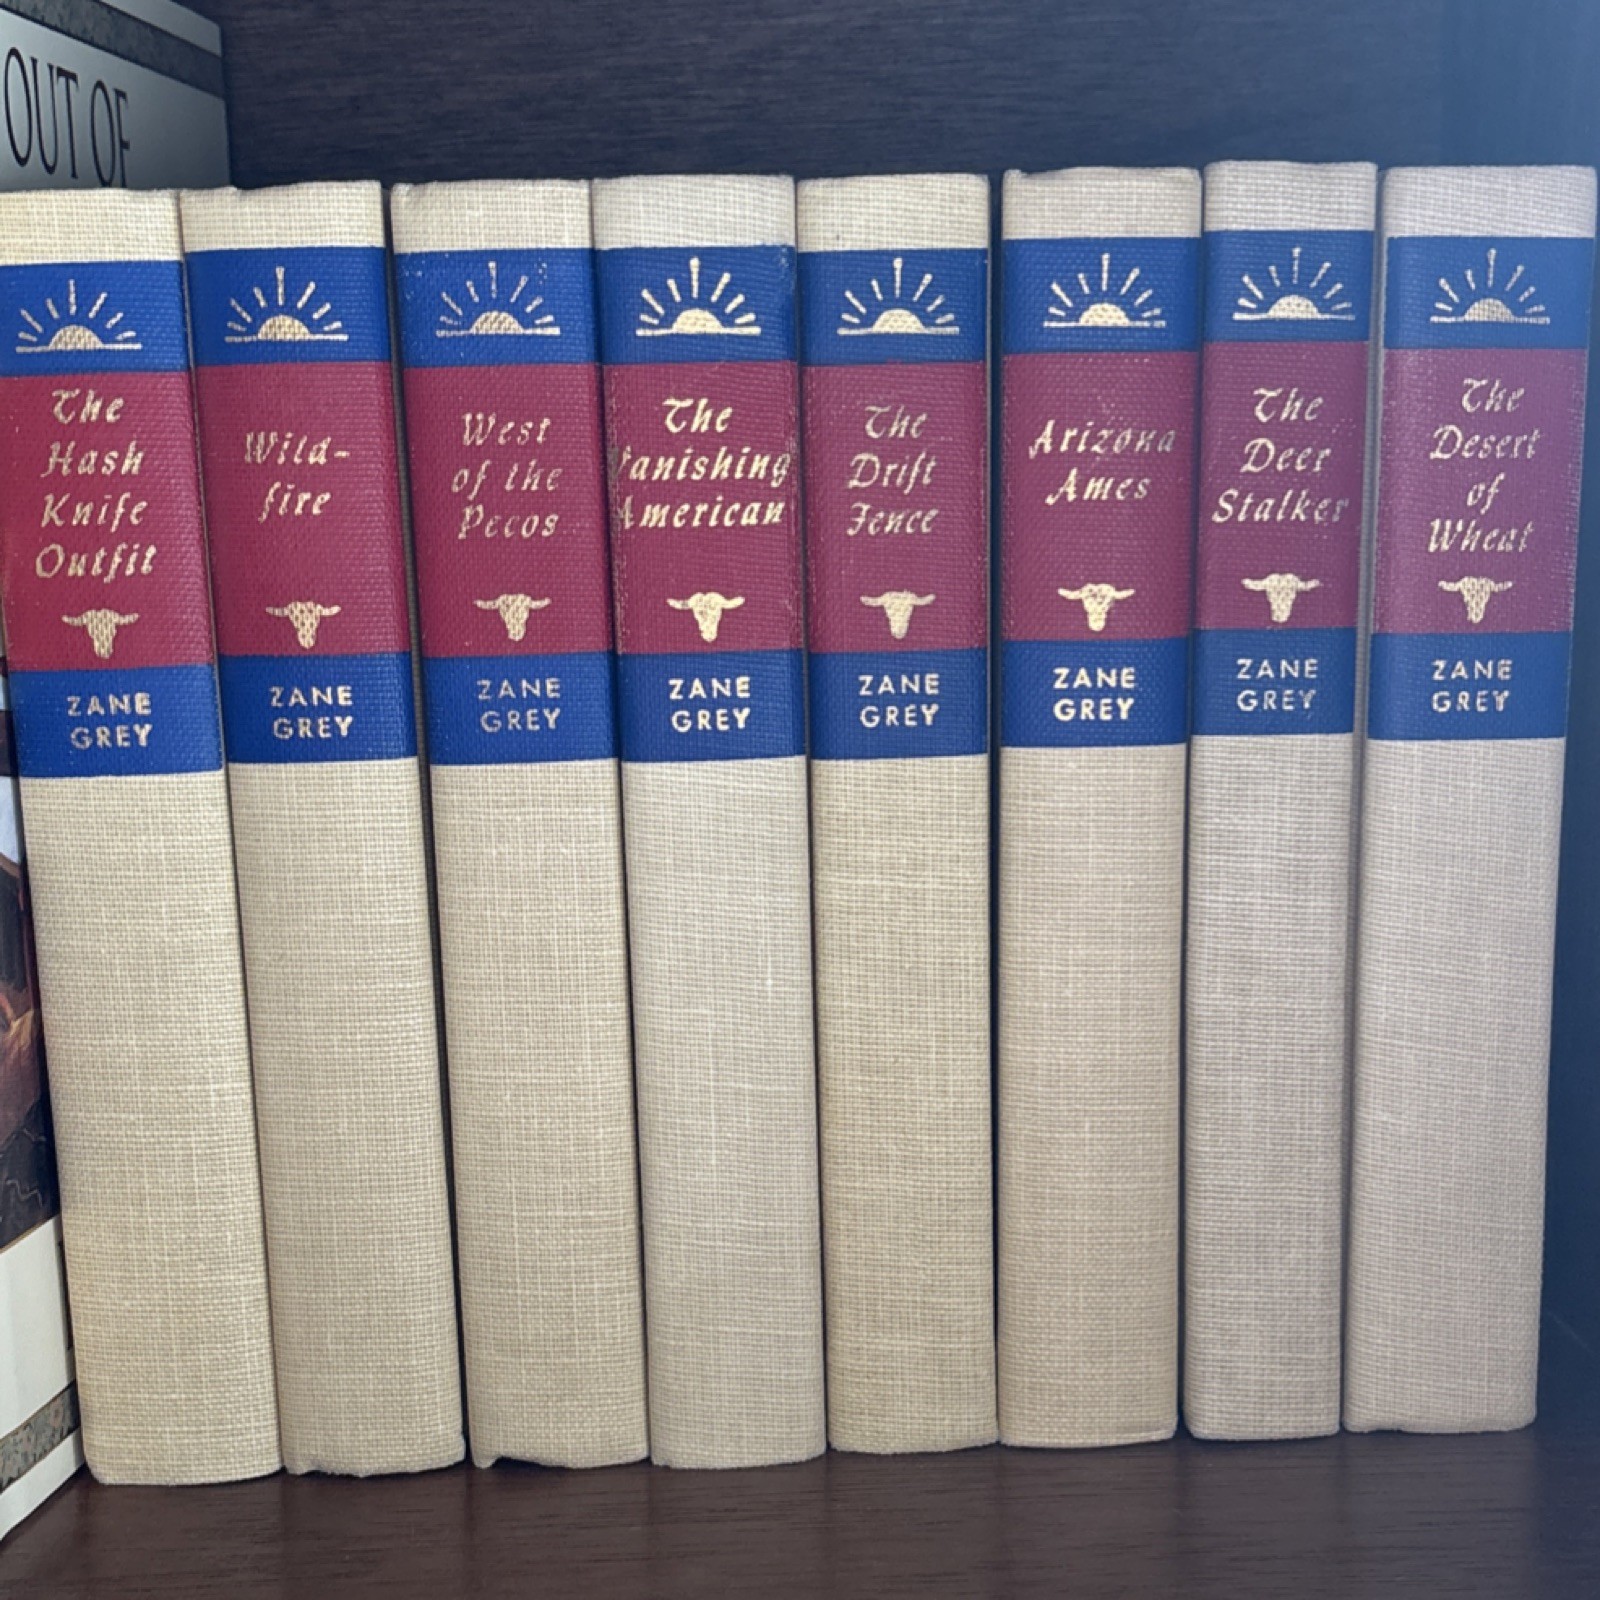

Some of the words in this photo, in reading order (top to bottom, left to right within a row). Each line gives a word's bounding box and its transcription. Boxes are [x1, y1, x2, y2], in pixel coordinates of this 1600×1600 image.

[5, 47, 79, 179] OUT
[90, 80, 130, 188] OF
[52, 388, 125, 424] The
[1253, 387, 1324, 423] The
[1461, 378, 1524, 413] The
[462, 412, 552, 446] West
[662, 397, 733, 433] The
[864, 405, 927, 439] The
[244, 431, 350, 465] Wild-
[1028, 419, 1177, 459] Arizona
[1240, 438, 1332, 473] Deer
[1429, 425, 1541, 460] Desert
[41, 440, 145, 477] Hash
[847, 451, 937, 495] Drift
[451, 460, 491, 500] of
[504, 459, 563, 492] the
[1045, 468, 1152, 505] Ames
[1467, 473, 1505, 514] of
[41, 492, 148, 533] Knife
[258, 481, 332, 523] fire
[1211, 488, 1349, 523] Stalker
[458, 504, 559, 540] Pecos
[847, 502, 939, 537] Fence
[1427, 518, 1534, 552] Wheat
[35, 544, 157, 583] Outfit
[858, 673, 940, 695] ZANE
[1053, 667, 1135, 689] ZANE
[1236, 658, 1318, 680] ZANE
[1431, 659, 1513, 681] ZANE
[67, 693, 152, 717] ZANE
[269, 685, 353, 708] ZANE
[476, 678, 561, 700] ZANE
[669, 676, 751, 700] ZANE
[1237, 690, 1316, 713] GREY
[1431, 691, 1509, 713] GREY
[481, 708, 561, 733] GREY
[671, 707, 751, 733] GREY
[860, 703, 939, 727] GREY
[1054, 698, 1135, 722] GREY
[70, 723, 153, 750] GREY
[272, 716, 354, 740] GREY
